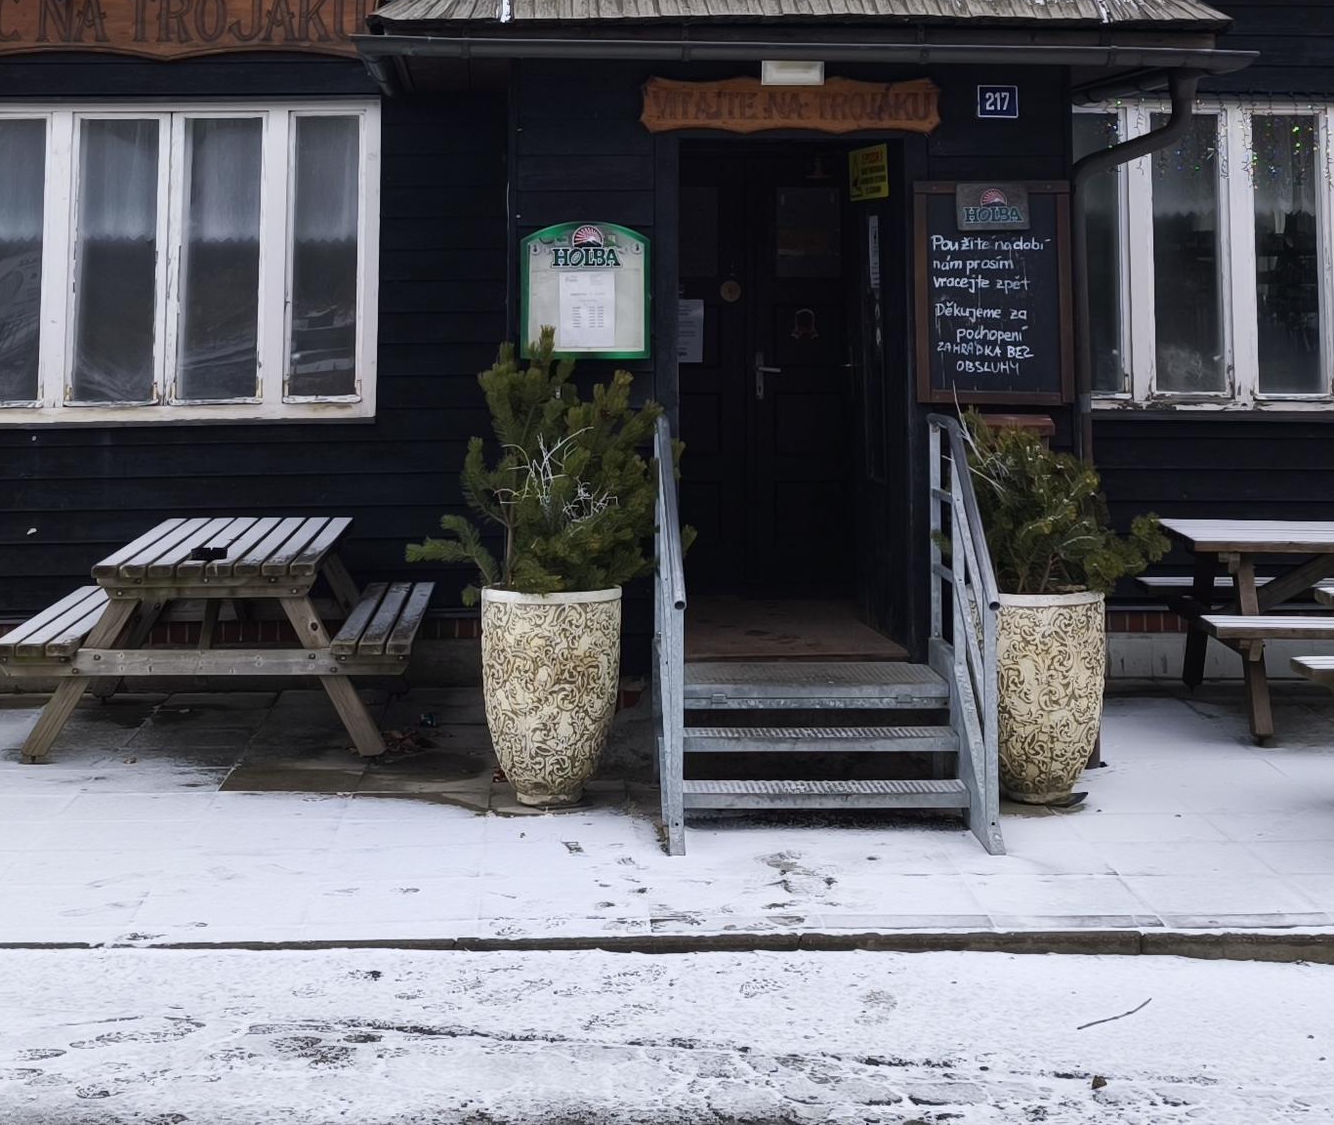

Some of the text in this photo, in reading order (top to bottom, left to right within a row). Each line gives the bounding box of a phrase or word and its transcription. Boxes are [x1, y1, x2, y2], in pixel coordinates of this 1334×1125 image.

[985, 91, 1010, 111] 217
[963, 206, 1024, 223] HOLBA
[552, 247, 621, 267] HOLBA
[933, 255, 1014, 275] nám prosím
[935, 301, 1027, 323] Děkujeme za
[1007, 345, 1034, 359] BEZ
[956, 360, 1020, 375] OBSLUHY
